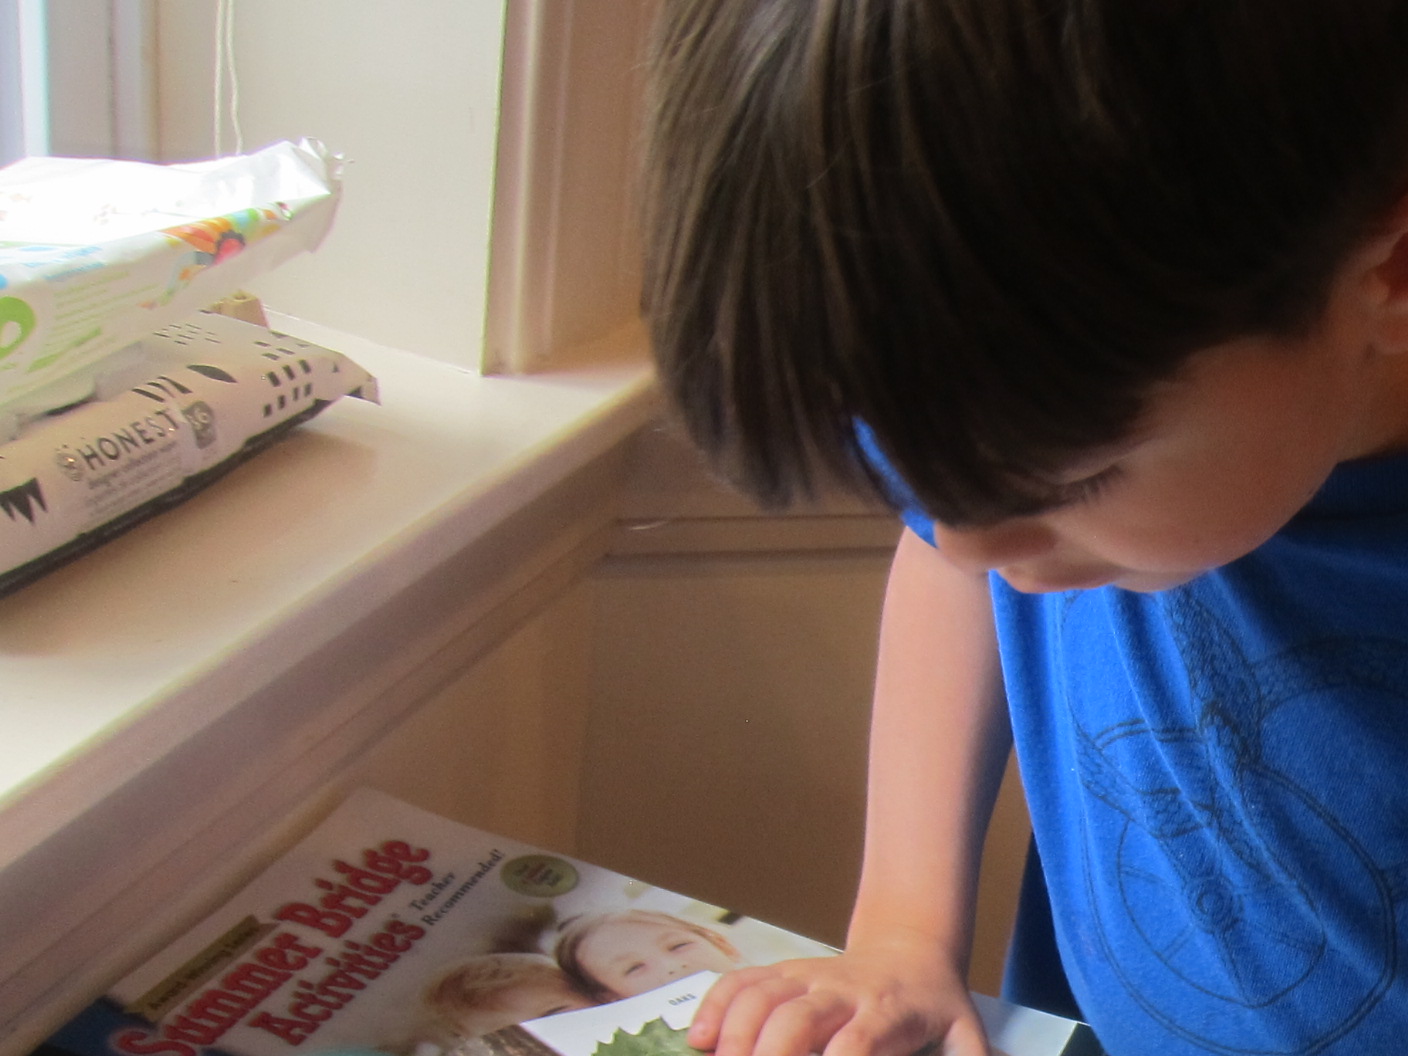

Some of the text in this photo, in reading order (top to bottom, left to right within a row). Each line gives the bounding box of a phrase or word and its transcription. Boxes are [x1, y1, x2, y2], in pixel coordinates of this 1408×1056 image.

[77, 409, 180, 470] HONEST
[275, 838, 435, 938] Bridge
[410, 871, 456, 912] Teacher
[421, 849, 507, 927] Recommended!
[249, 918, 426, 1046] Activities
[669, 993, 696, 1006] OAKS
